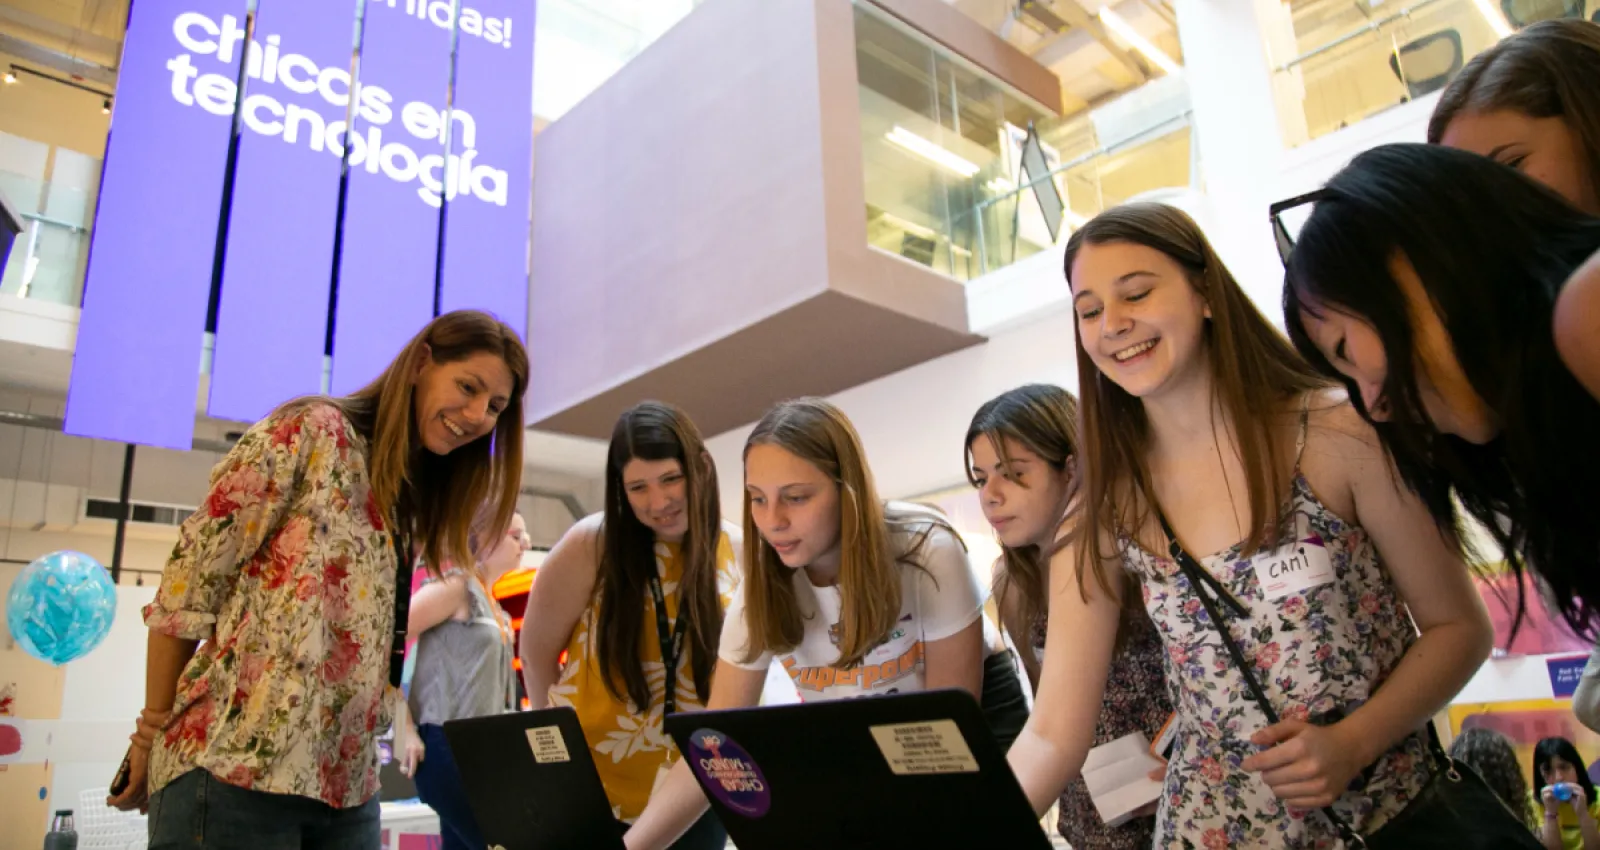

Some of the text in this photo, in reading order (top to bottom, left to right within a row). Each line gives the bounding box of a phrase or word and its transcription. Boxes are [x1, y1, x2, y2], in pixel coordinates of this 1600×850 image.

[166, 53, 509, 208] tecnología
[172, 12, 477, 150] chicas en
